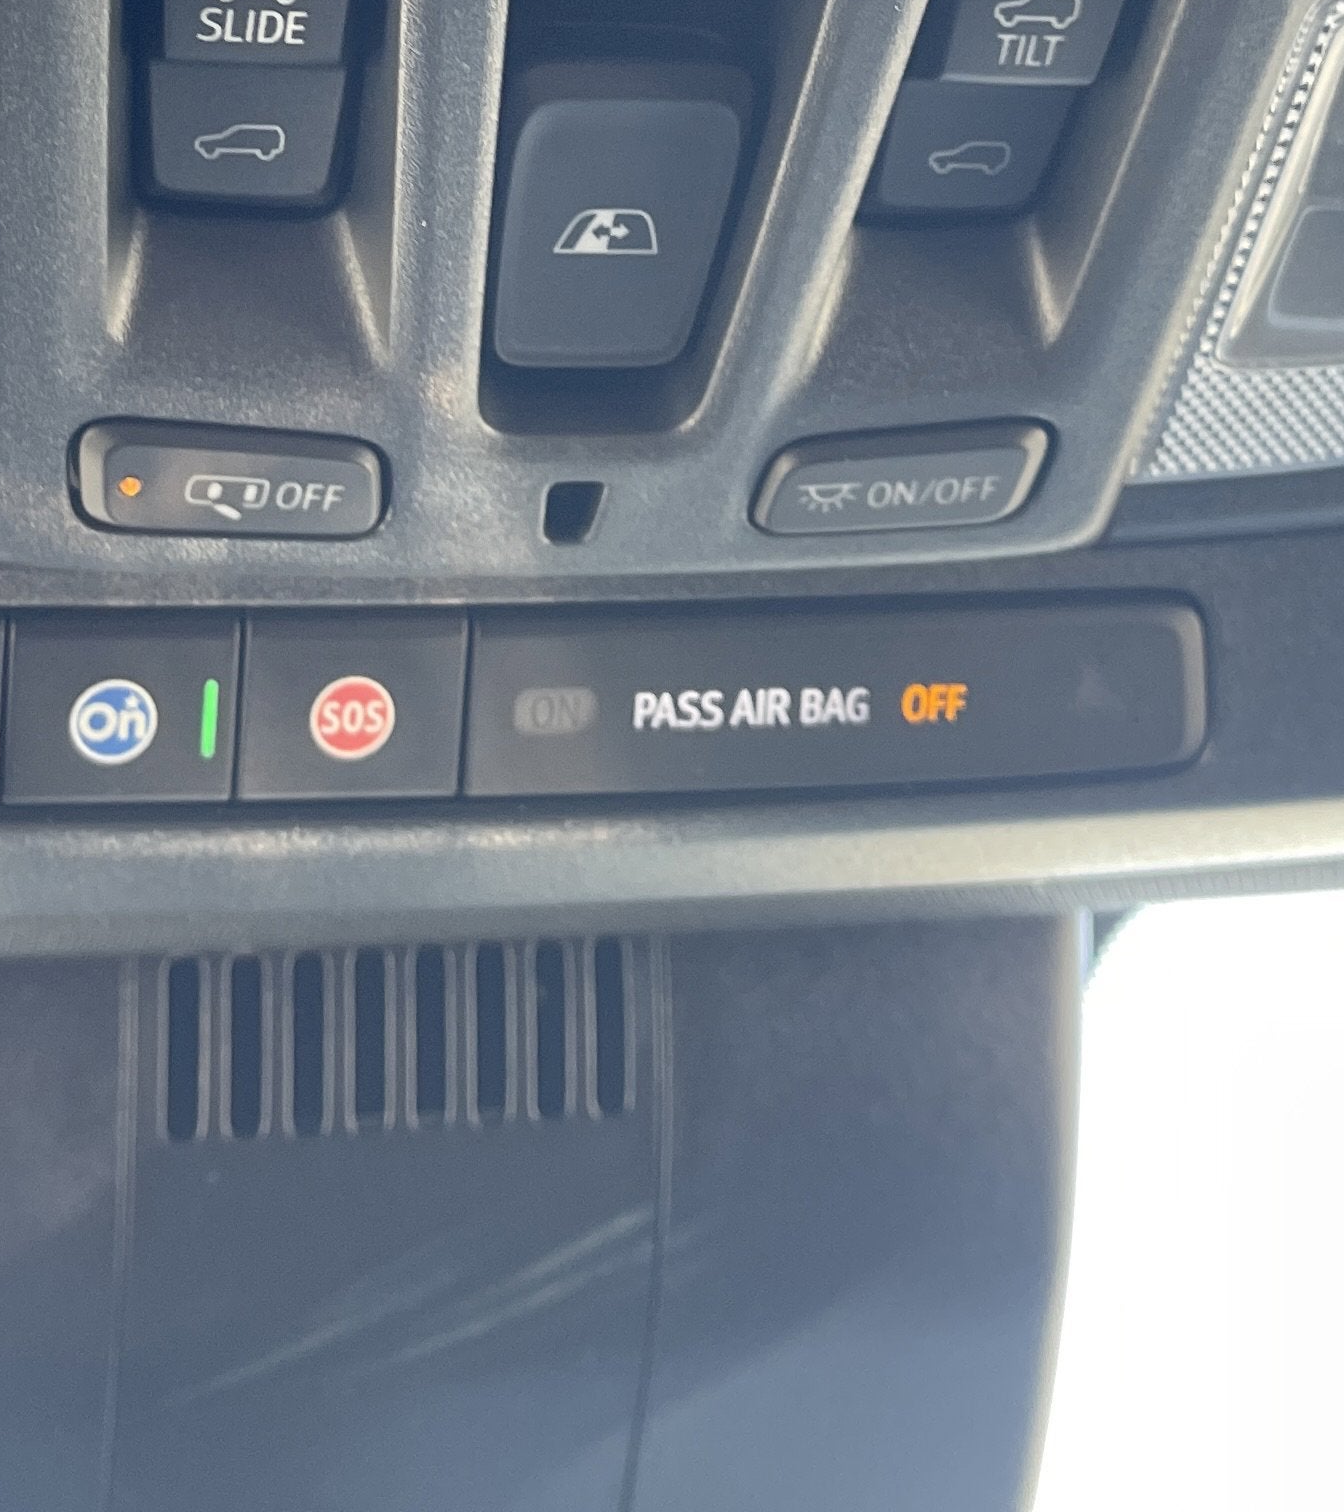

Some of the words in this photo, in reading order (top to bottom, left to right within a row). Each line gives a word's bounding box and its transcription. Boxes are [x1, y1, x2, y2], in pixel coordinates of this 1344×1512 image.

[196, 7, 308, 45] SLIDE
[997, 33, 1065, 67] TILT
[275, 481, 346, 512] OFF
[866, 475, 1001, 508] ON/OFF
[320, 700, 384, 735] SOS
[633, 690, 723, 729] PASS
[729, 687, 791, 727] AIR
[800, 687, 870, 725] BAG
[901, 683, 968, 724] OFF
